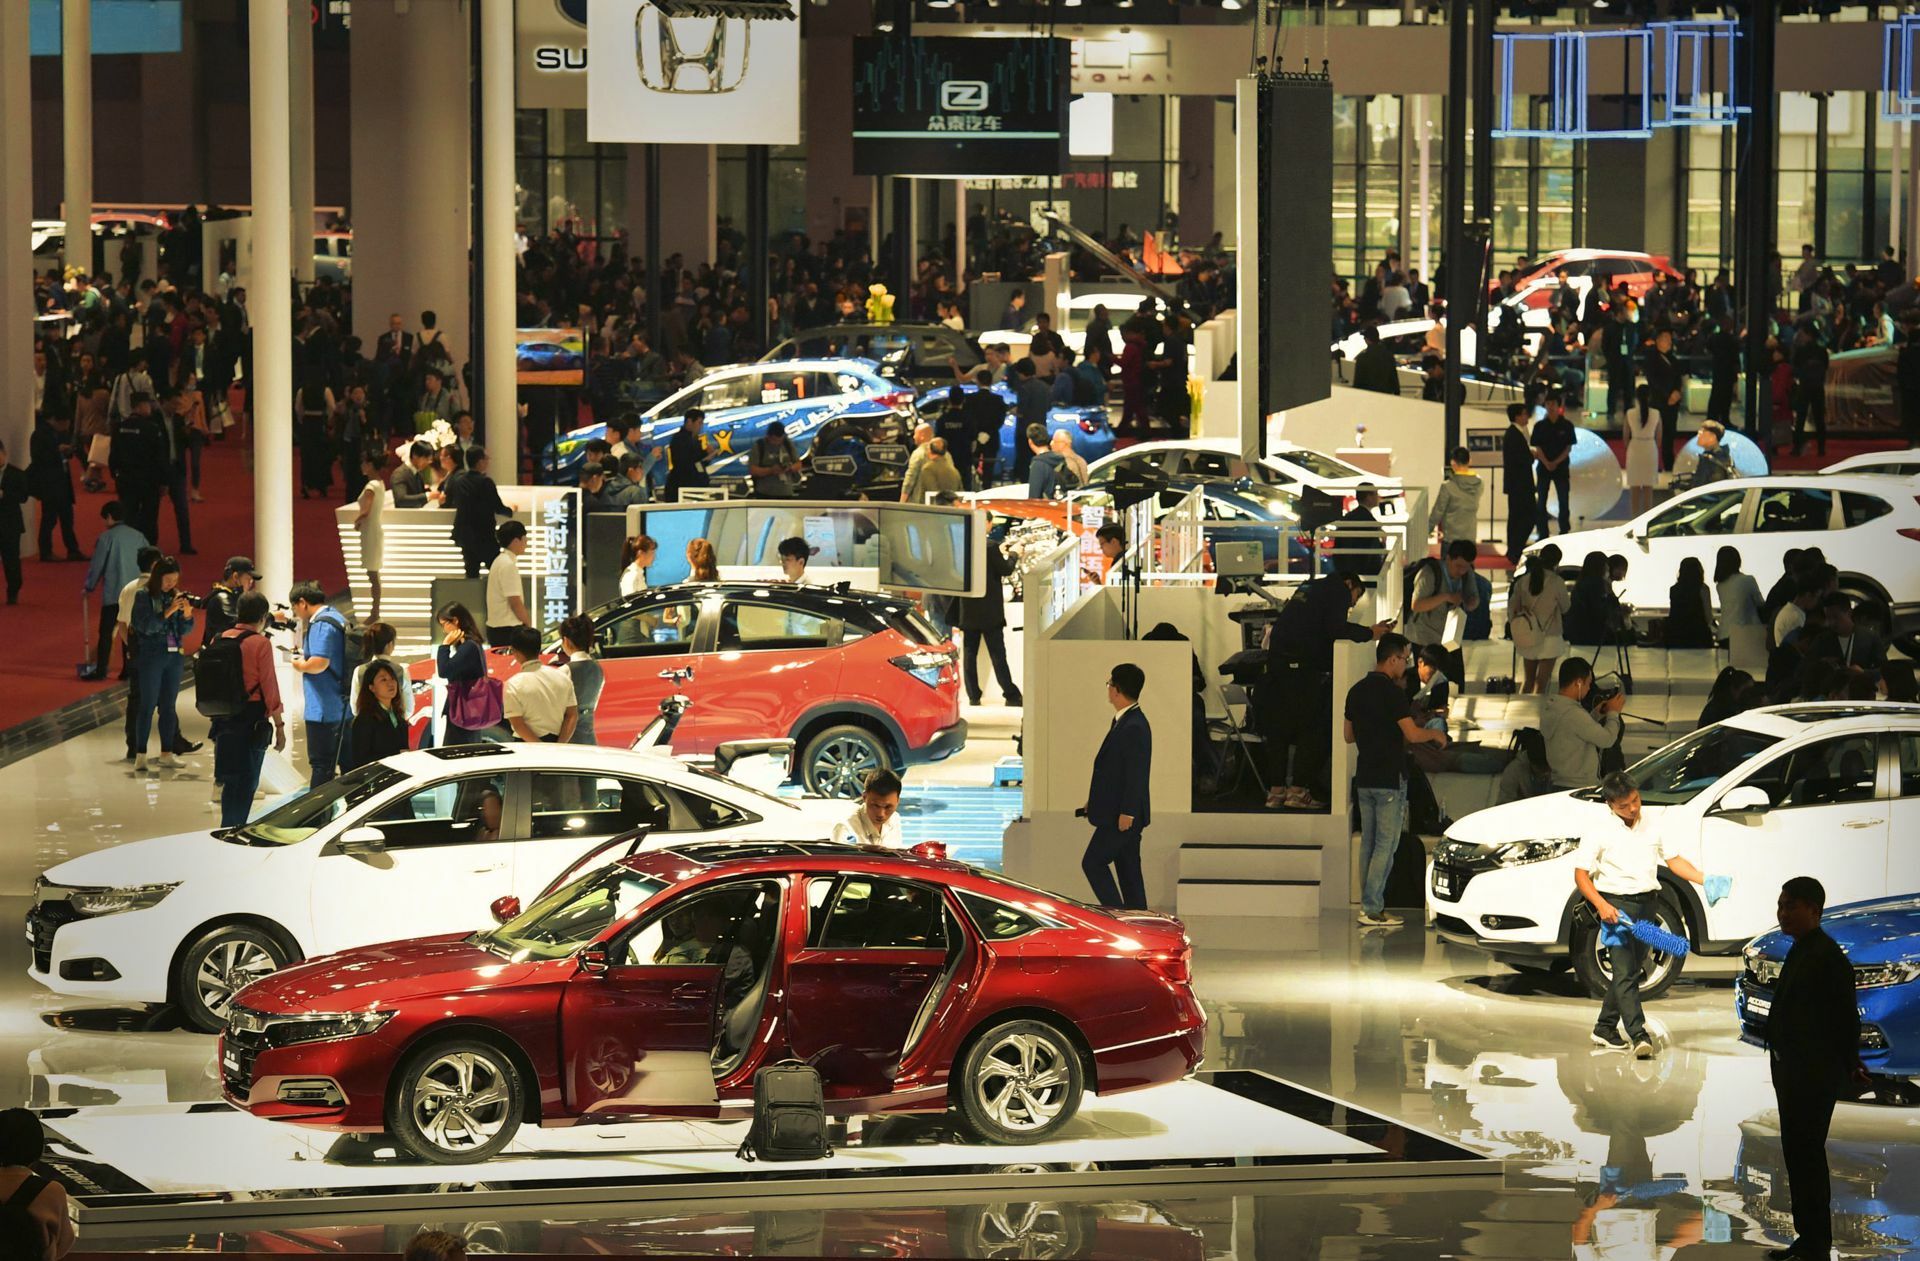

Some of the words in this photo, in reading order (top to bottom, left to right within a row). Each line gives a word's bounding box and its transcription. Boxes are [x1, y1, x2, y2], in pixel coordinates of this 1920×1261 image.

[536, 48, 587, 69] SU
[927, 115, 1003, 131] 众泰汽车
[793, 376, 805, 399] 1
[543, 500, 569, 632] 实时位置共
